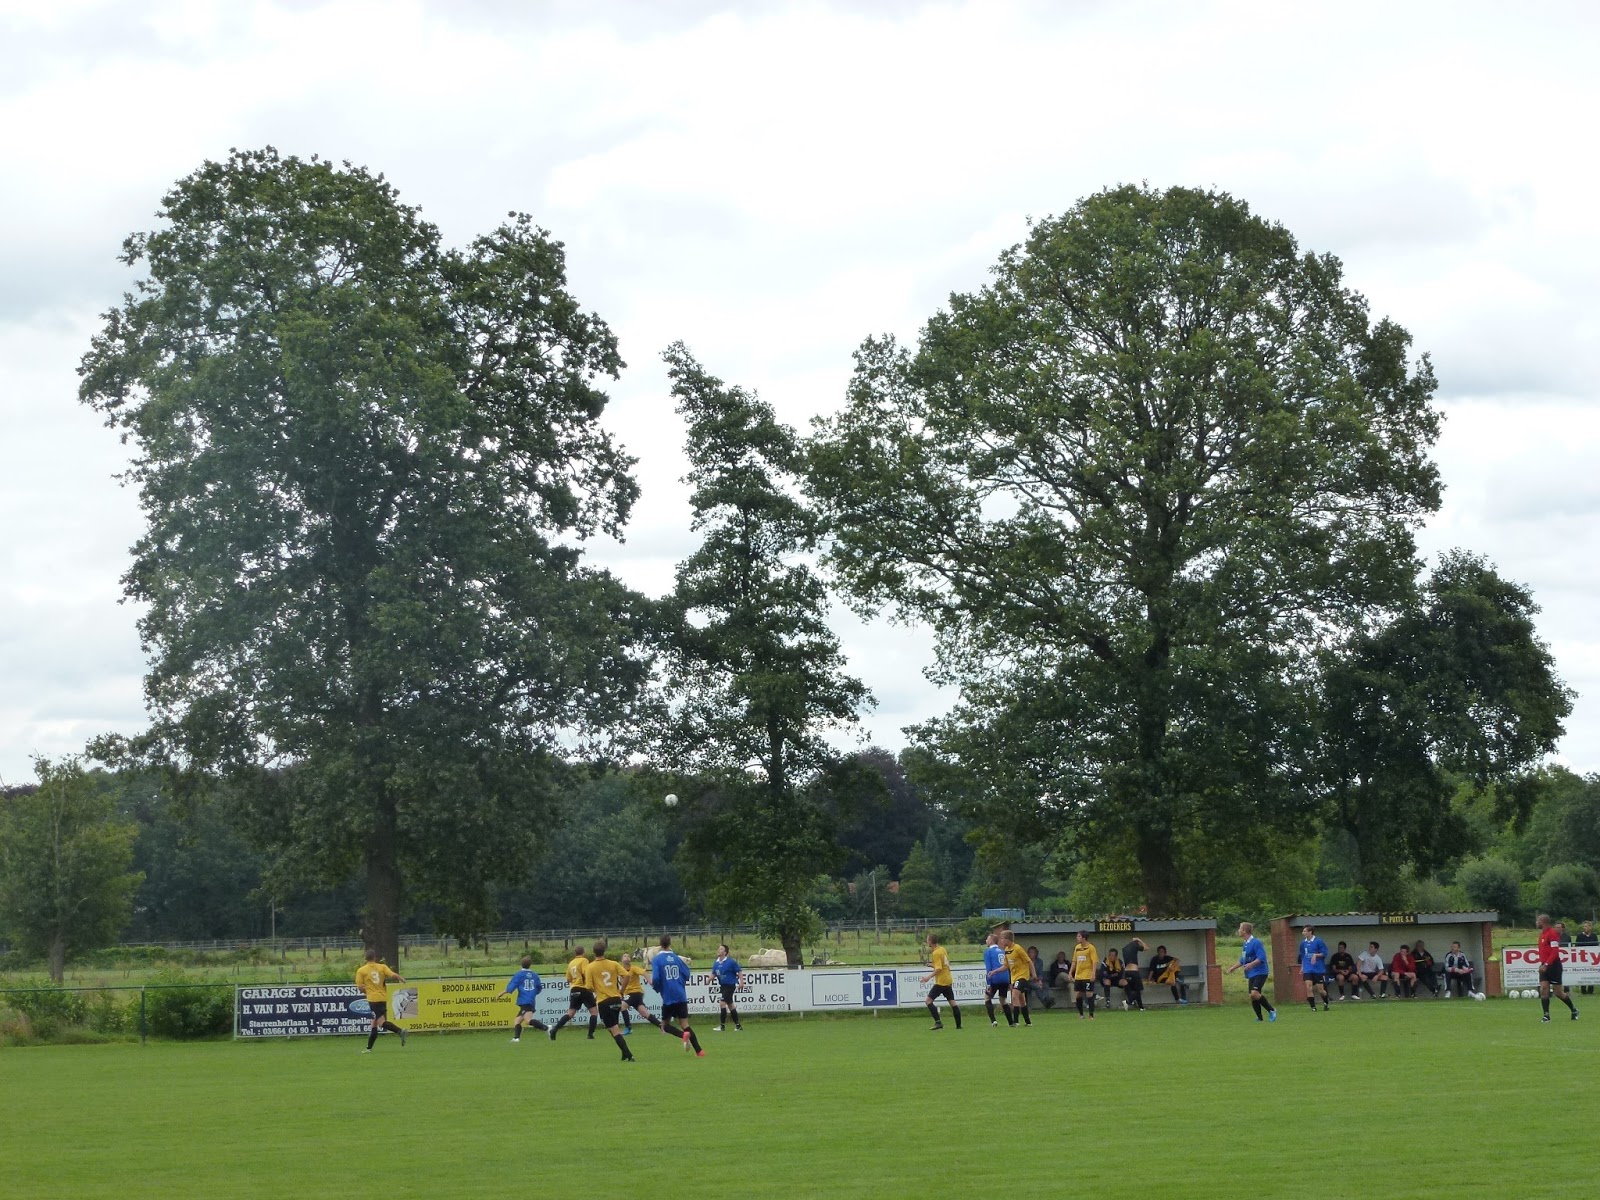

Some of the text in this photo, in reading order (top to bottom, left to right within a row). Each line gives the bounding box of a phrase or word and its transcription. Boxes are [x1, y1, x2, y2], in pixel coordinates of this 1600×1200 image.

[1100, 922, 1131, 931] BEZOEKERS
[370, 971, 379, 984] 3
[665, 965, 679, 980] 10
[601, 971, 612, 986] 2
[442, 984, 464, 993] BROOD
[472, 983, 495, 992] BANKET
[523, 979, 535, 991] 11
[541, 980, 570, 991] arage
[242, 988, 296, 999] GARAGE
[824, 994, 849, 1002] MODE
[456, 997, 489, 1005] LAMBRECHTS
[547, 996, 570, 1004] Speciali
[687, 994, 785, 1004] ard Va Loo & Co
[243, 1002, 347, 1015] H. VAN DE VEN B.V.B.A.
[249, 1019, 307, 1027] Starrenhoflaan
[341, 1017, 372, 1025] Kapelle
[263, 1027, 285, 1035] 03/664
[300, 1026, 308, 1034] 90
[317, 1026, 331, 1034] Fax
[338, 1025, 360, 1033] 03/664
